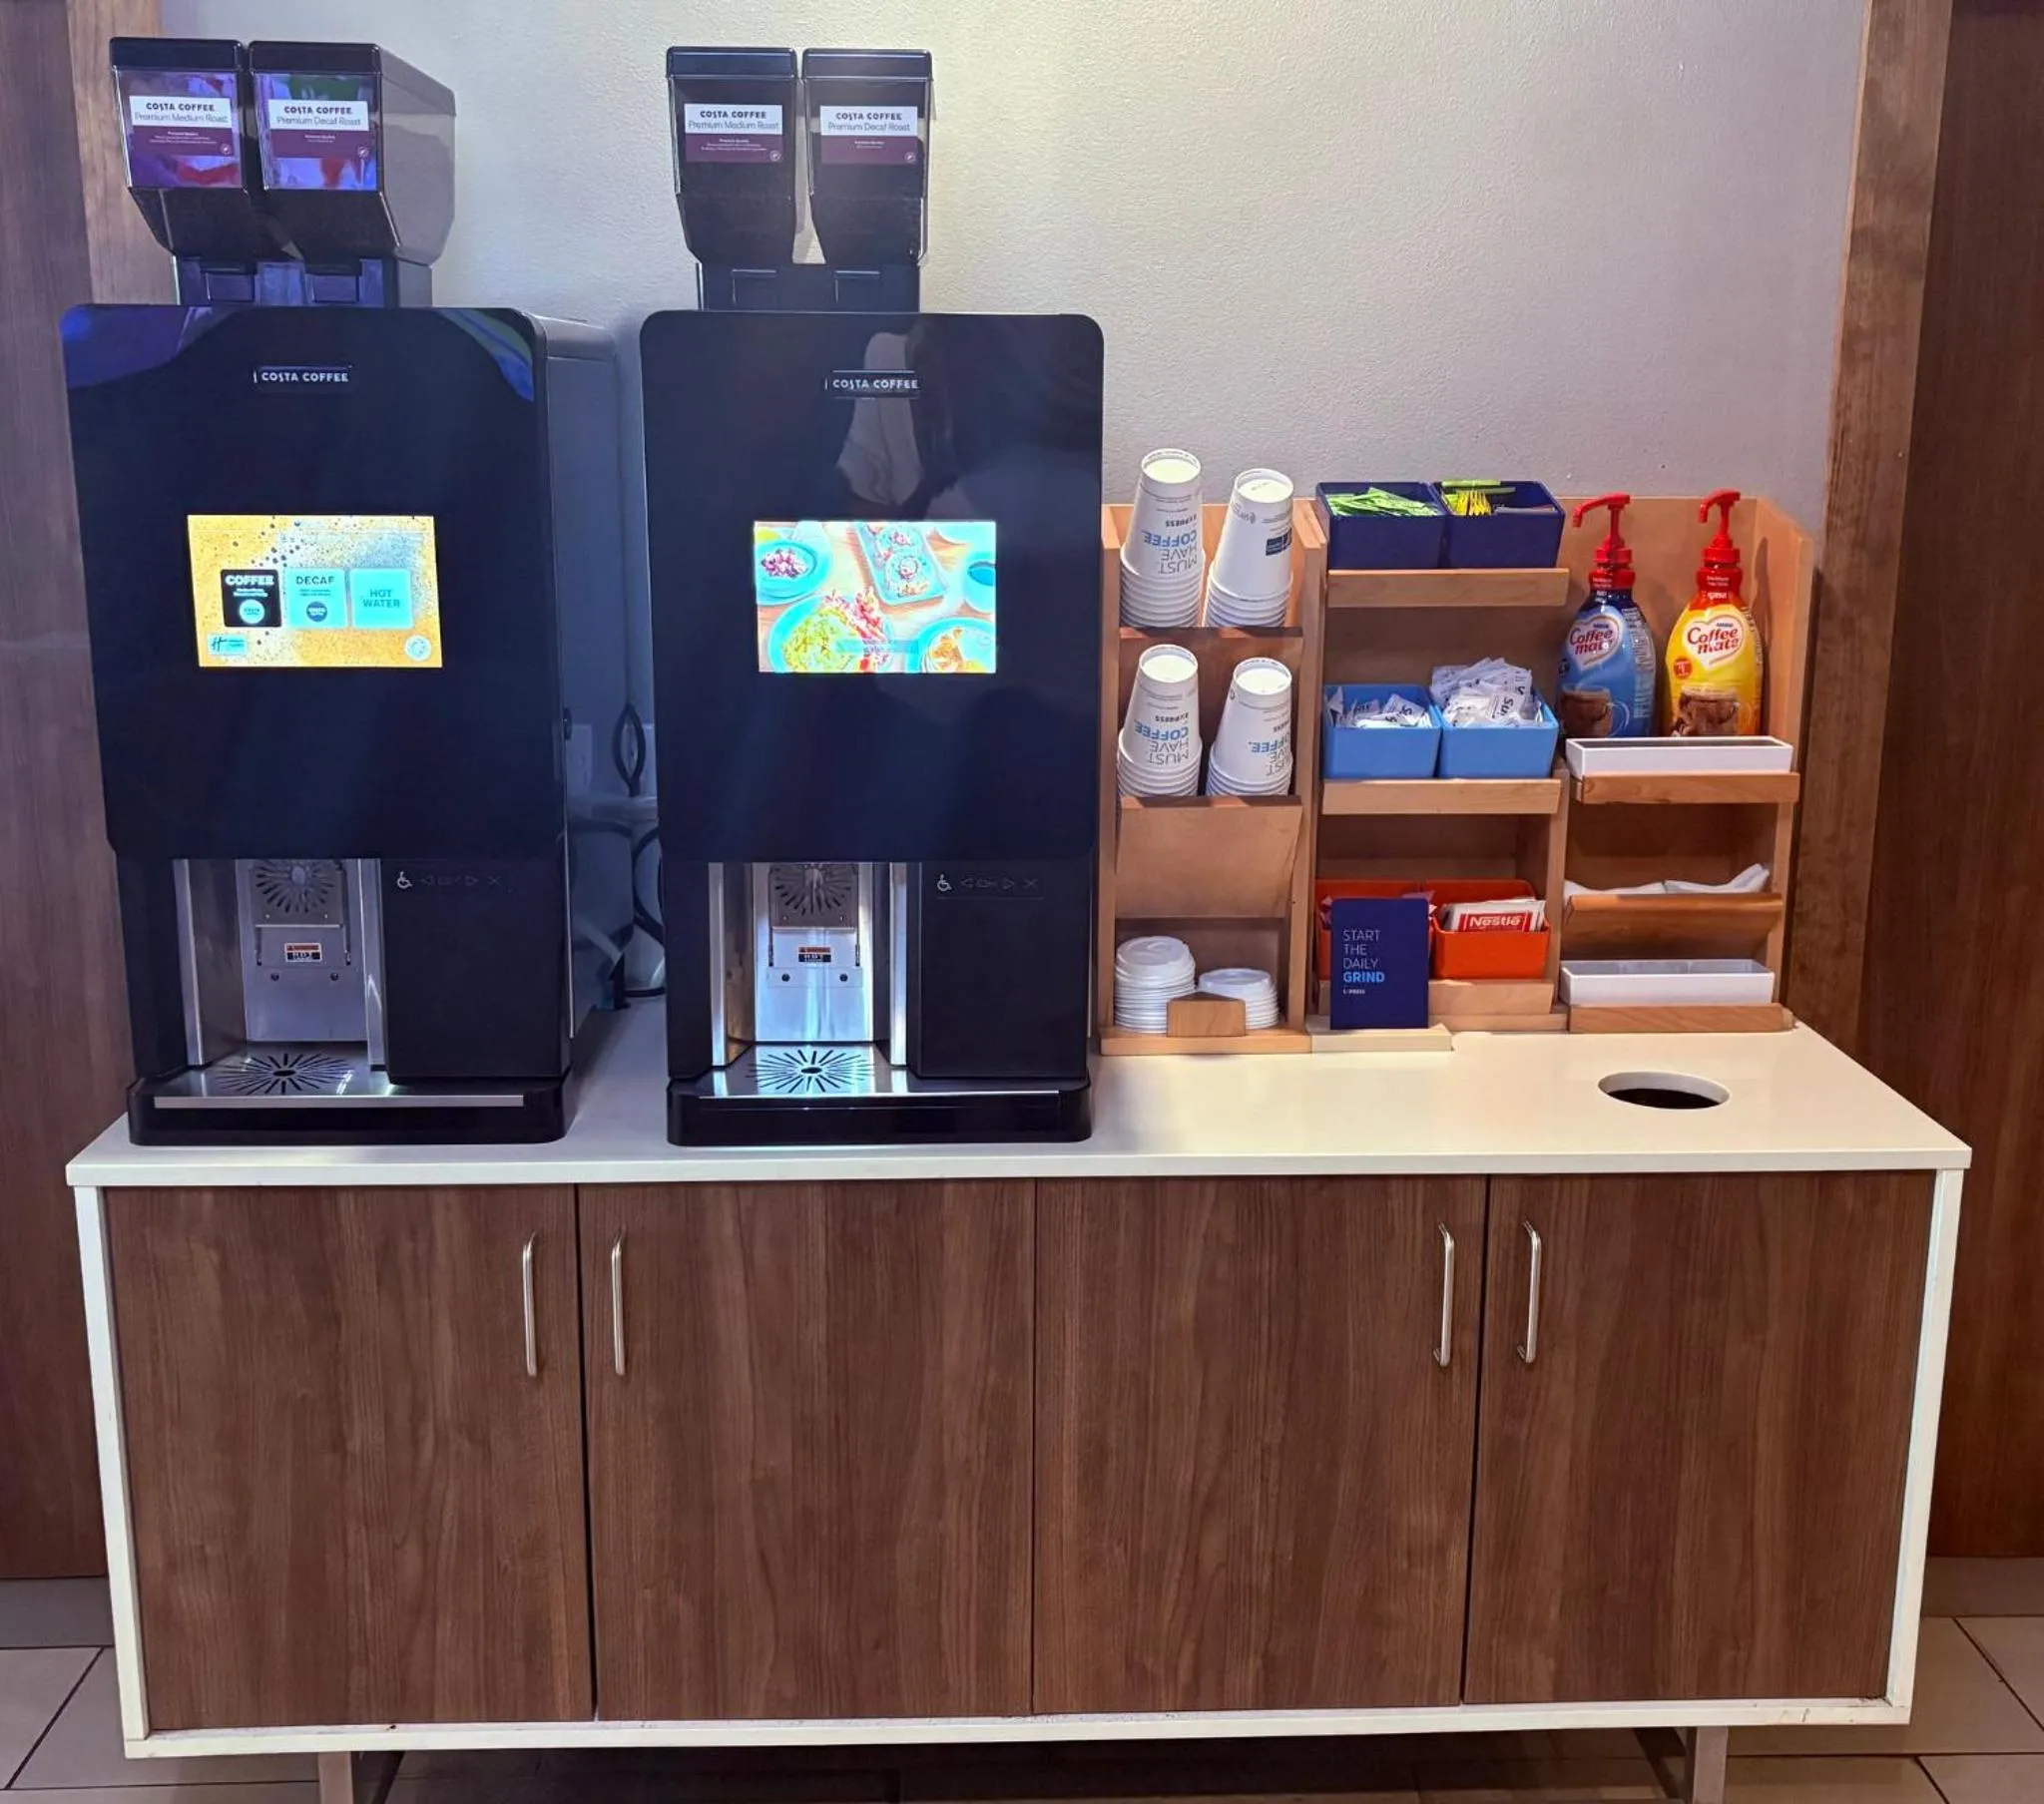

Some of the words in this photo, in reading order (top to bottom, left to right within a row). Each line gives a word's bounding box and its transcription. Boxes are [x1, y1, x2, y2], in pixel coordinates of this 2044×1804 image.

[146, 102, 175, 111] COSTA
[178, 103, 215, 112] COFFEE
[284, 106, 313, 115] COSTA
[276, 116, 313, 125] Premium
[688, 120, 723, 130] Premium
[724, 121, 756, 130] Medium
[827, 122, 862, 131] Premium
[864, 122, 887, 132] Decaf
[888, 123, 910, 132] Roast
[260, 372, 298, 382] COSTA
[302, 372, 349, 382] COFFEE
[832, 379, 869, 390] COSTA
[873, 379, 919, 389] COFFEE
[295, 575, 335, 586] DECAF
[369, 589, 392, 598] HOT
[362, 599, 400, 609] WATER
[1570, 628, 1613, 646] Coffee
[1687, 627, 1739, 645] Coffee
[1698, 638, 1739, 655] mate
[1342, 929, 1381, 942] START
[1343, 943, 1367, 956] THE
[1342, 957, 1378, 970] DAILY
[1342, 971, 1385, 983] GRIND
